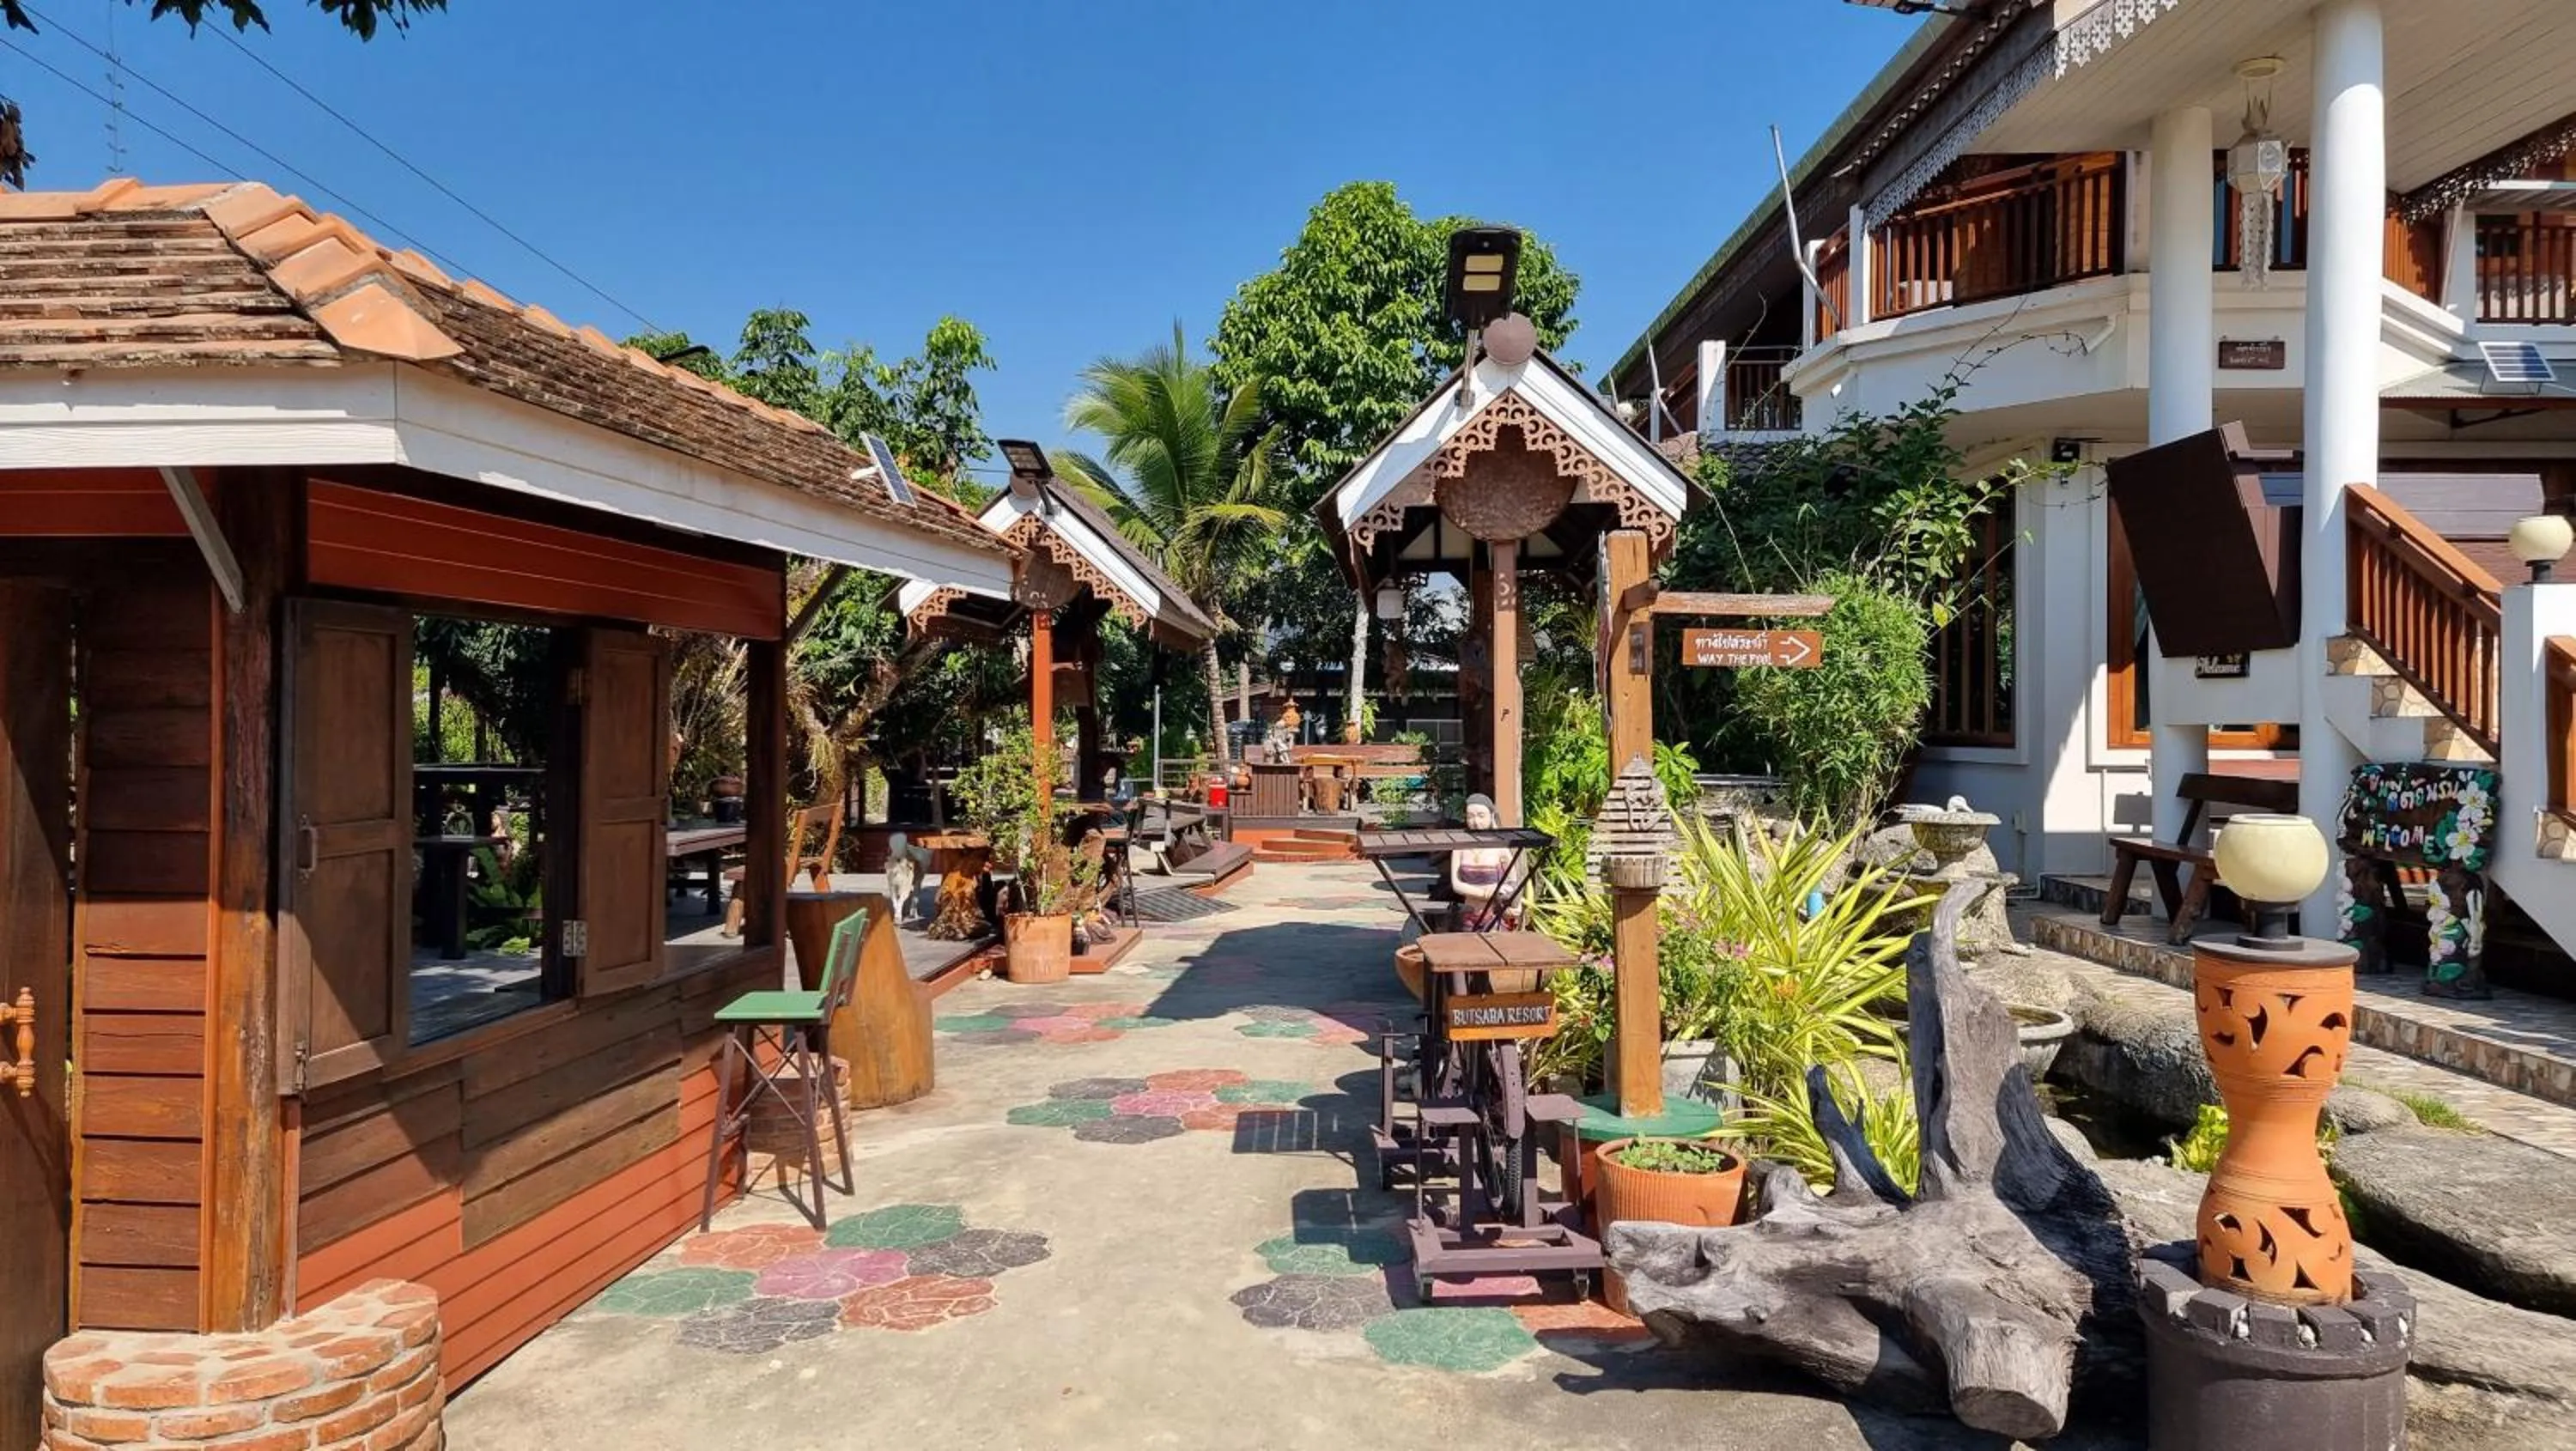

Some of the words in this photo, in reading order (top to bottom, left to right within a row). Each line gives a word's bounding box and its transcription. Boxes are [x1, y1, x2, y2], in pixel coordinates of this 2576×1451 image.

[1698, 653, 1722, 665] WAY
[1728, 653, 1747, 665] THE
[2361, 823, 2435, 854] WELCOME
[1507, 1005, 1552, 1023] RESORT
